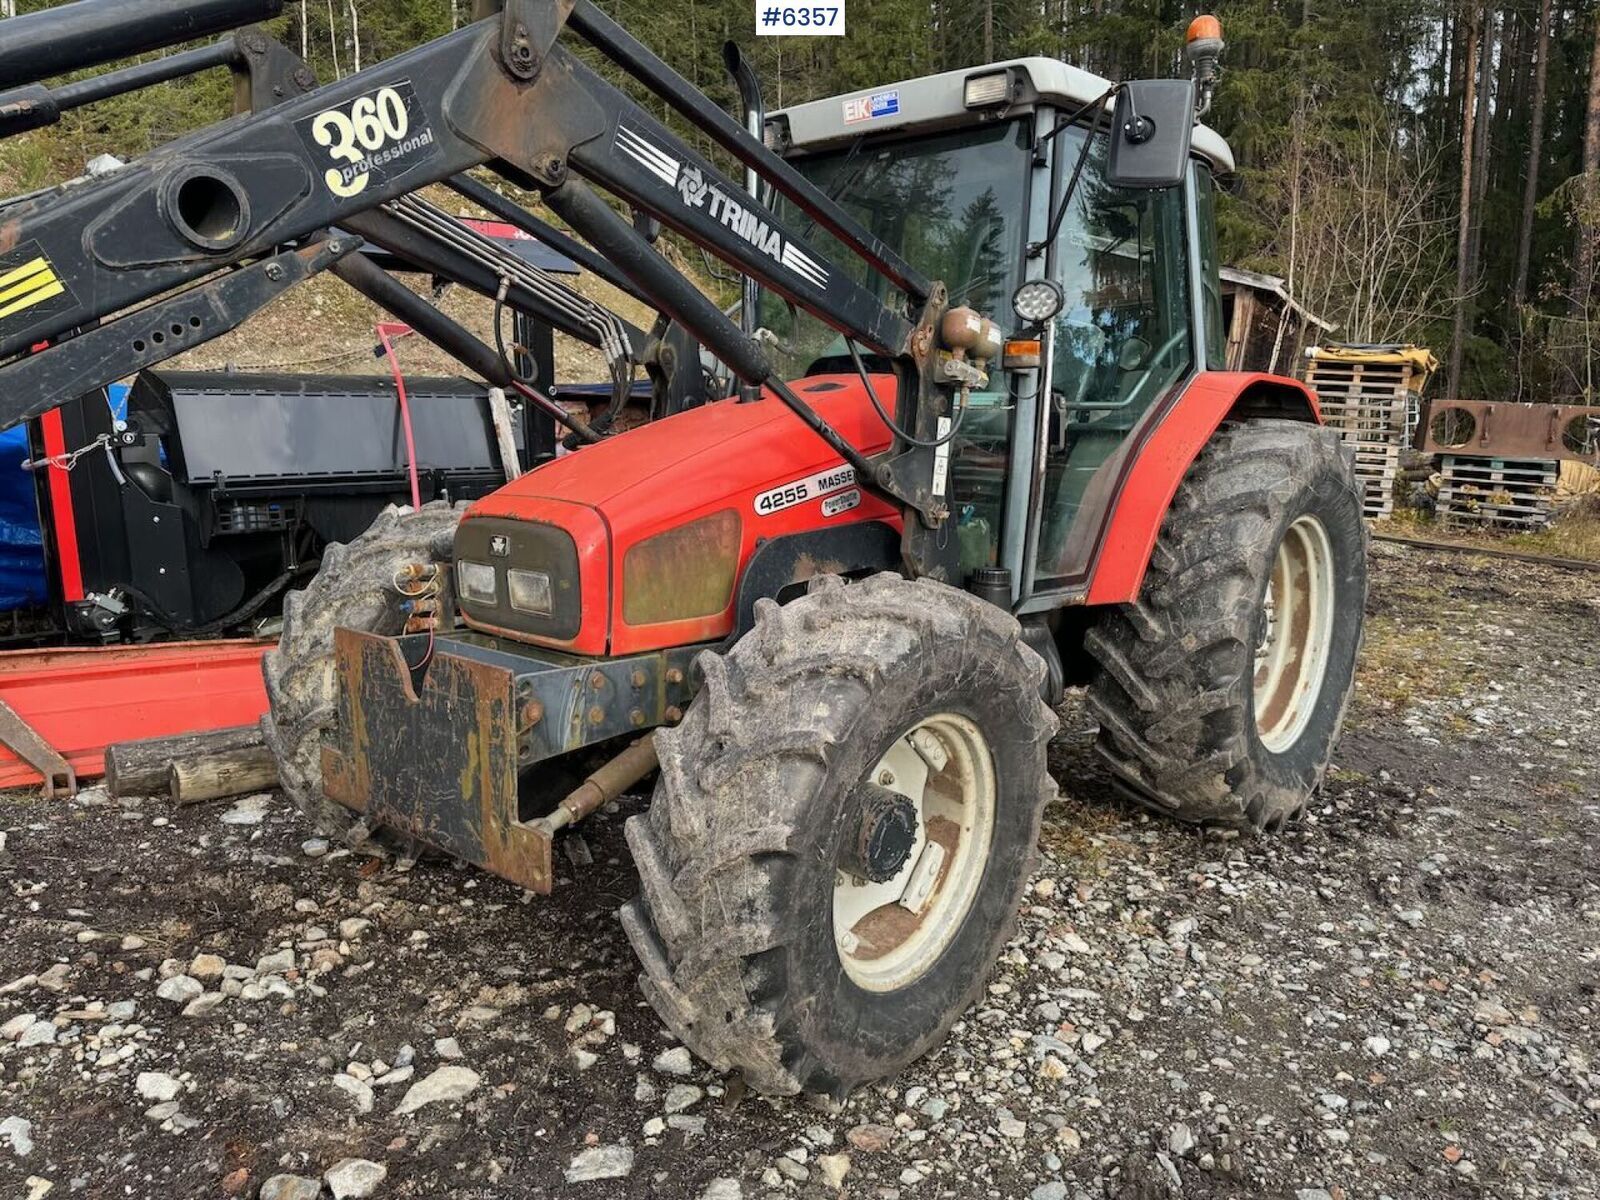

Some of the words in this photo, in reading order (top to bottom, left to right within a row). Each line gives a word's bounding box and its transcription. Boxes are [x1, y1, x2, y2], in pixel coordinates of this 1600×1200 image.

[312, 87, 408, 197] 360
[341, 127, 434, 183] professional
[707, 184, 782, 263] TRIMA
[760, 484, 808, 510] 4255
[818, 469, 856, 491] MASSE
